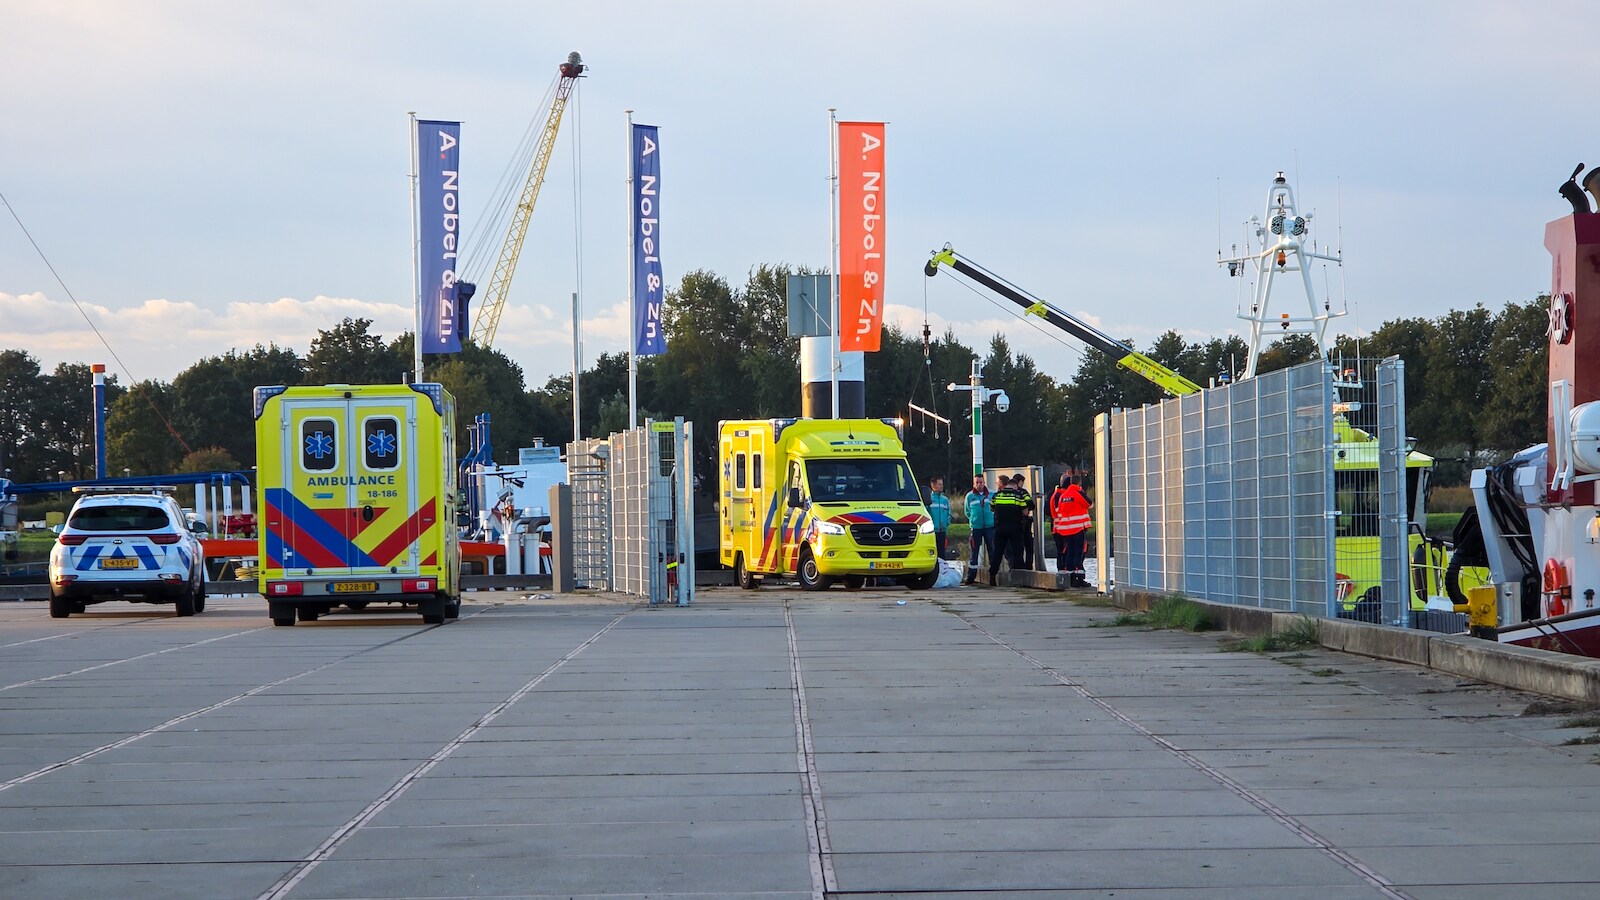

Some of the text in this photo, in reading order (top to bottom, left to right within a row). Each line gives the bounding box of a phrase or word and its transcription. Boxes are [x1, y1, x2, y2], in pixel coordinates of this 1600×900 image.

[438, 130, 457, 160] A.
[861, 131, 881, 161] A.
[442, 170, 459, 260] Nobel
[641, 135, 661, 346] A. Nobel & Zn.
[442, 269, 458, 290] &
[863, 269, 879, 289] &
[855, 299, 878, 342] Zn.
[307, 475, 395, 486] AMBULANCE
[367, 490, 398, 498] 18-186
[104, 559, 134, 567] L-435-VT
[336, 583, 373, 591] Z-328-BT
